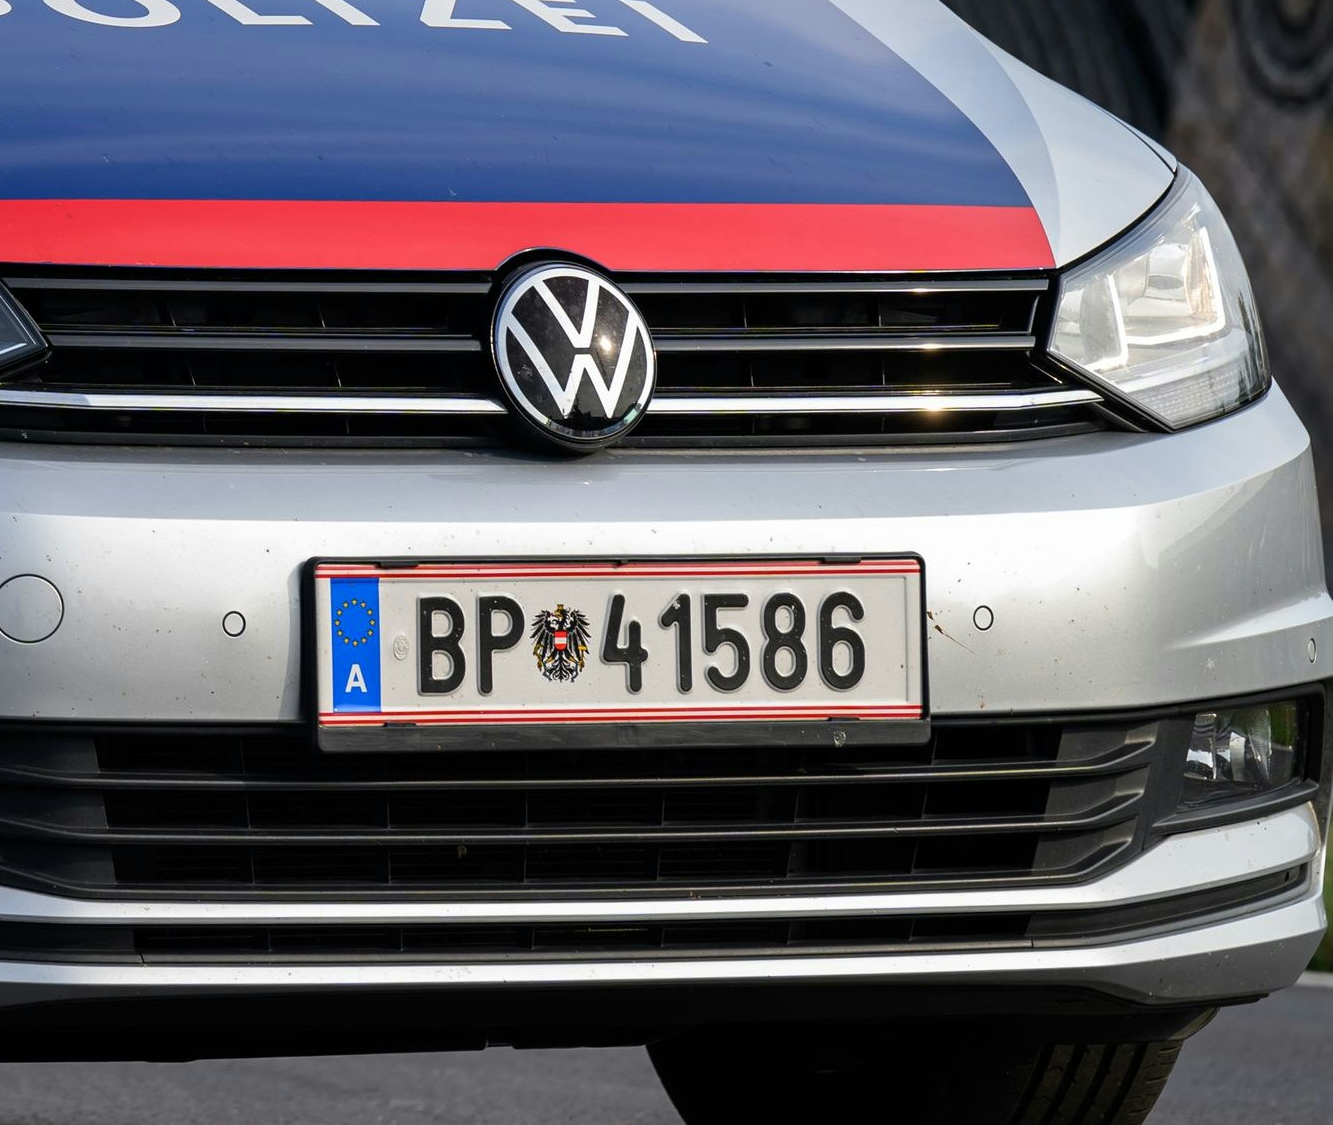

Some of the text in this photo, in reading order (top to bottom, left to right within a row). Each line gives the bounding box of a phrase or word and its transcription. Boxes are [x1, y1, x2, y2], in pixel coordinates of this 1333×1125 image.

[501, 273, 645, 421] VW
[345, 663, 368, 693] A
[418, 591, 866, 695] BP 41586
